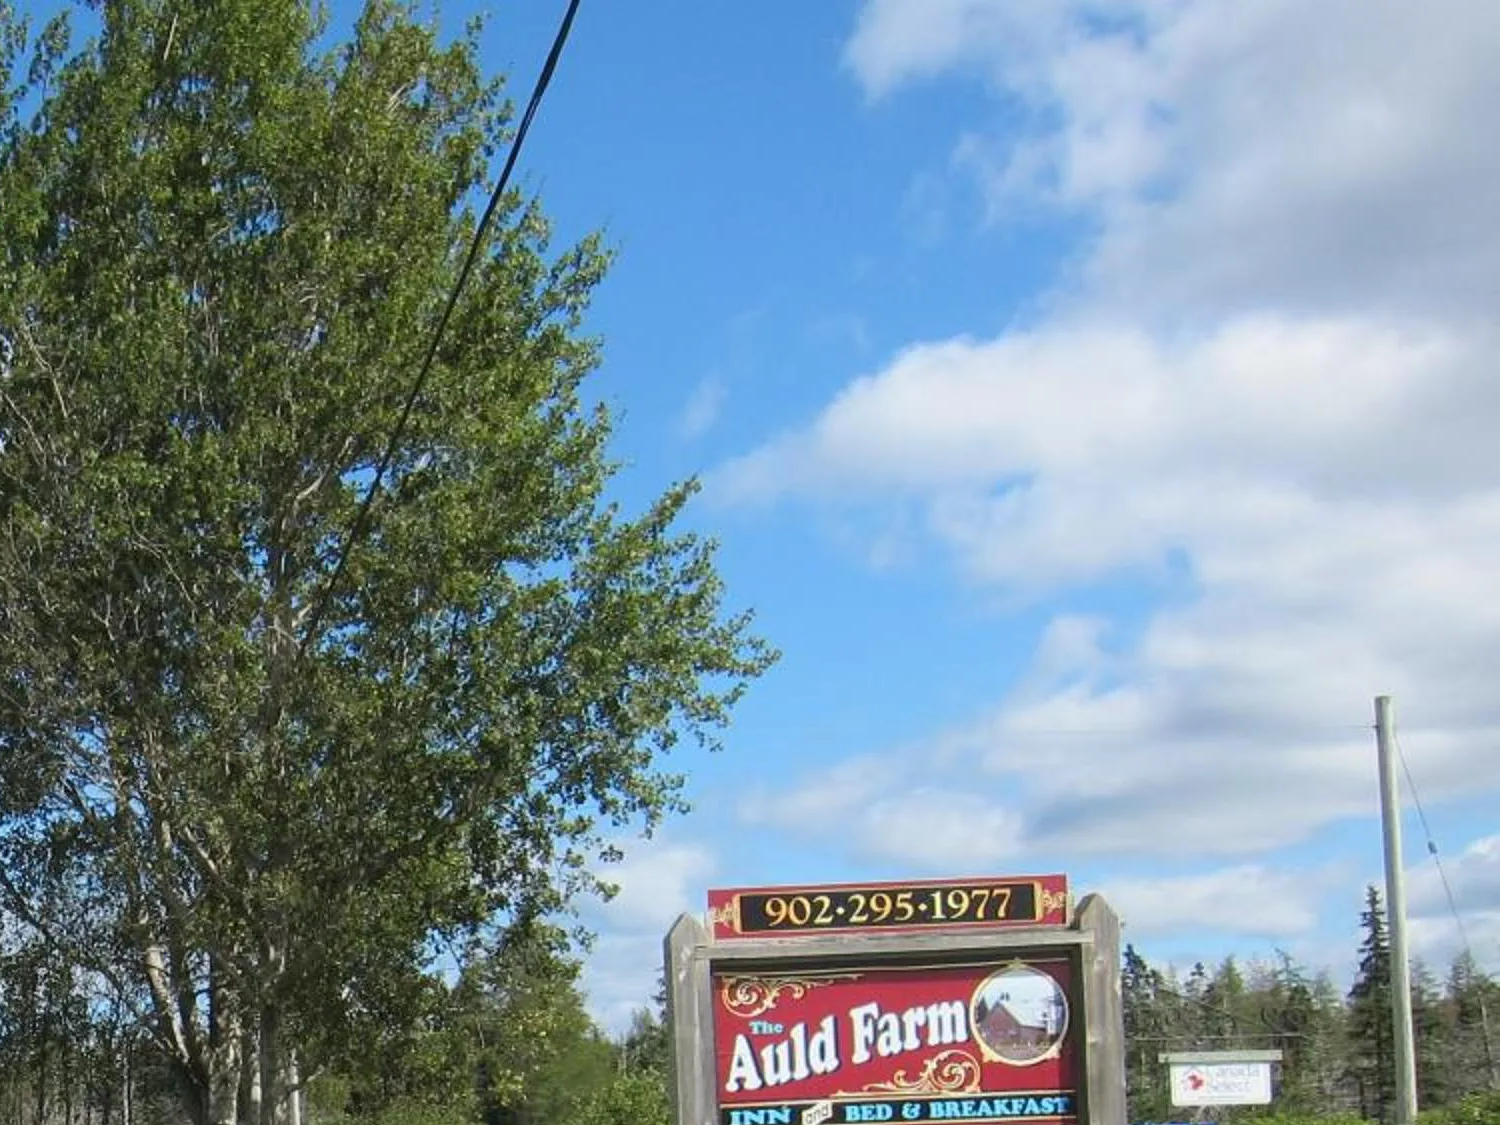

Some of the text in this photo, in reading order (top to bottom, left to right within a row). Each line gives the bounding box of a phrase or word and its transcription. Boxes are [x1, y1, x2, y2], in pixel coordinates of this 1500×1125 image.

[749, 1019, 784, 1034] The
[726, 1000, 968, 1092] Auld Farm
[804, 1103, 830, 1124] and
[844, 1103, 893, 1122] BED
[902, 1102, 921, 1119] &
[929, 1096, 1069, 1120] BREAKFAST
